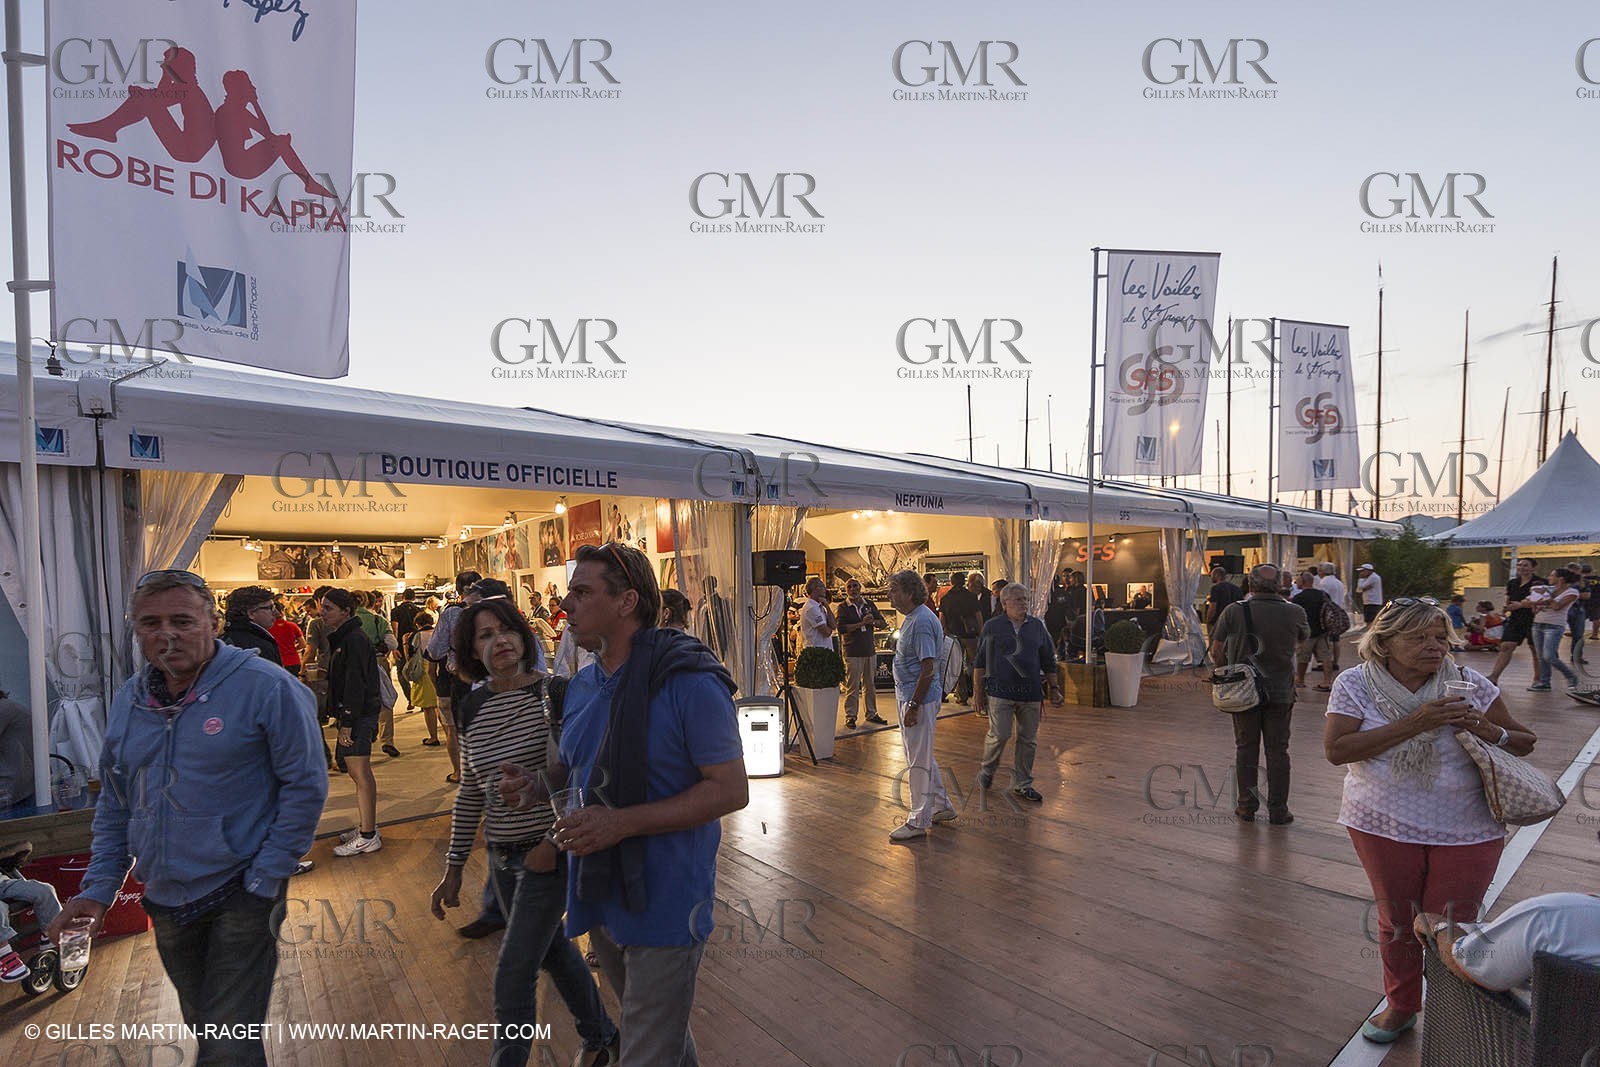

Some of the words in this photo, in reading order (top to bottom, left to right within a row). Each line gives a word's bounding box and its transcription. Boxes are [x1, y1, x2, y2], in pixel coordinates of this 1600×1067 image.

[56, 138, 175, 195] ROBE
[189, 171, 227, 204] DI
[240, 185, 348, 232] KAPPA
[1122, 258, 1147, 299] Les
[1152, 262, 1201, 300] Voiles
[1123, 306, 1136, 323] de
[381, 453, 500, 481] BOUTIQUE
[506, 463, 618, 489] OFFICIELLE
[895, 493, 944, 509] NEPTUNIA
